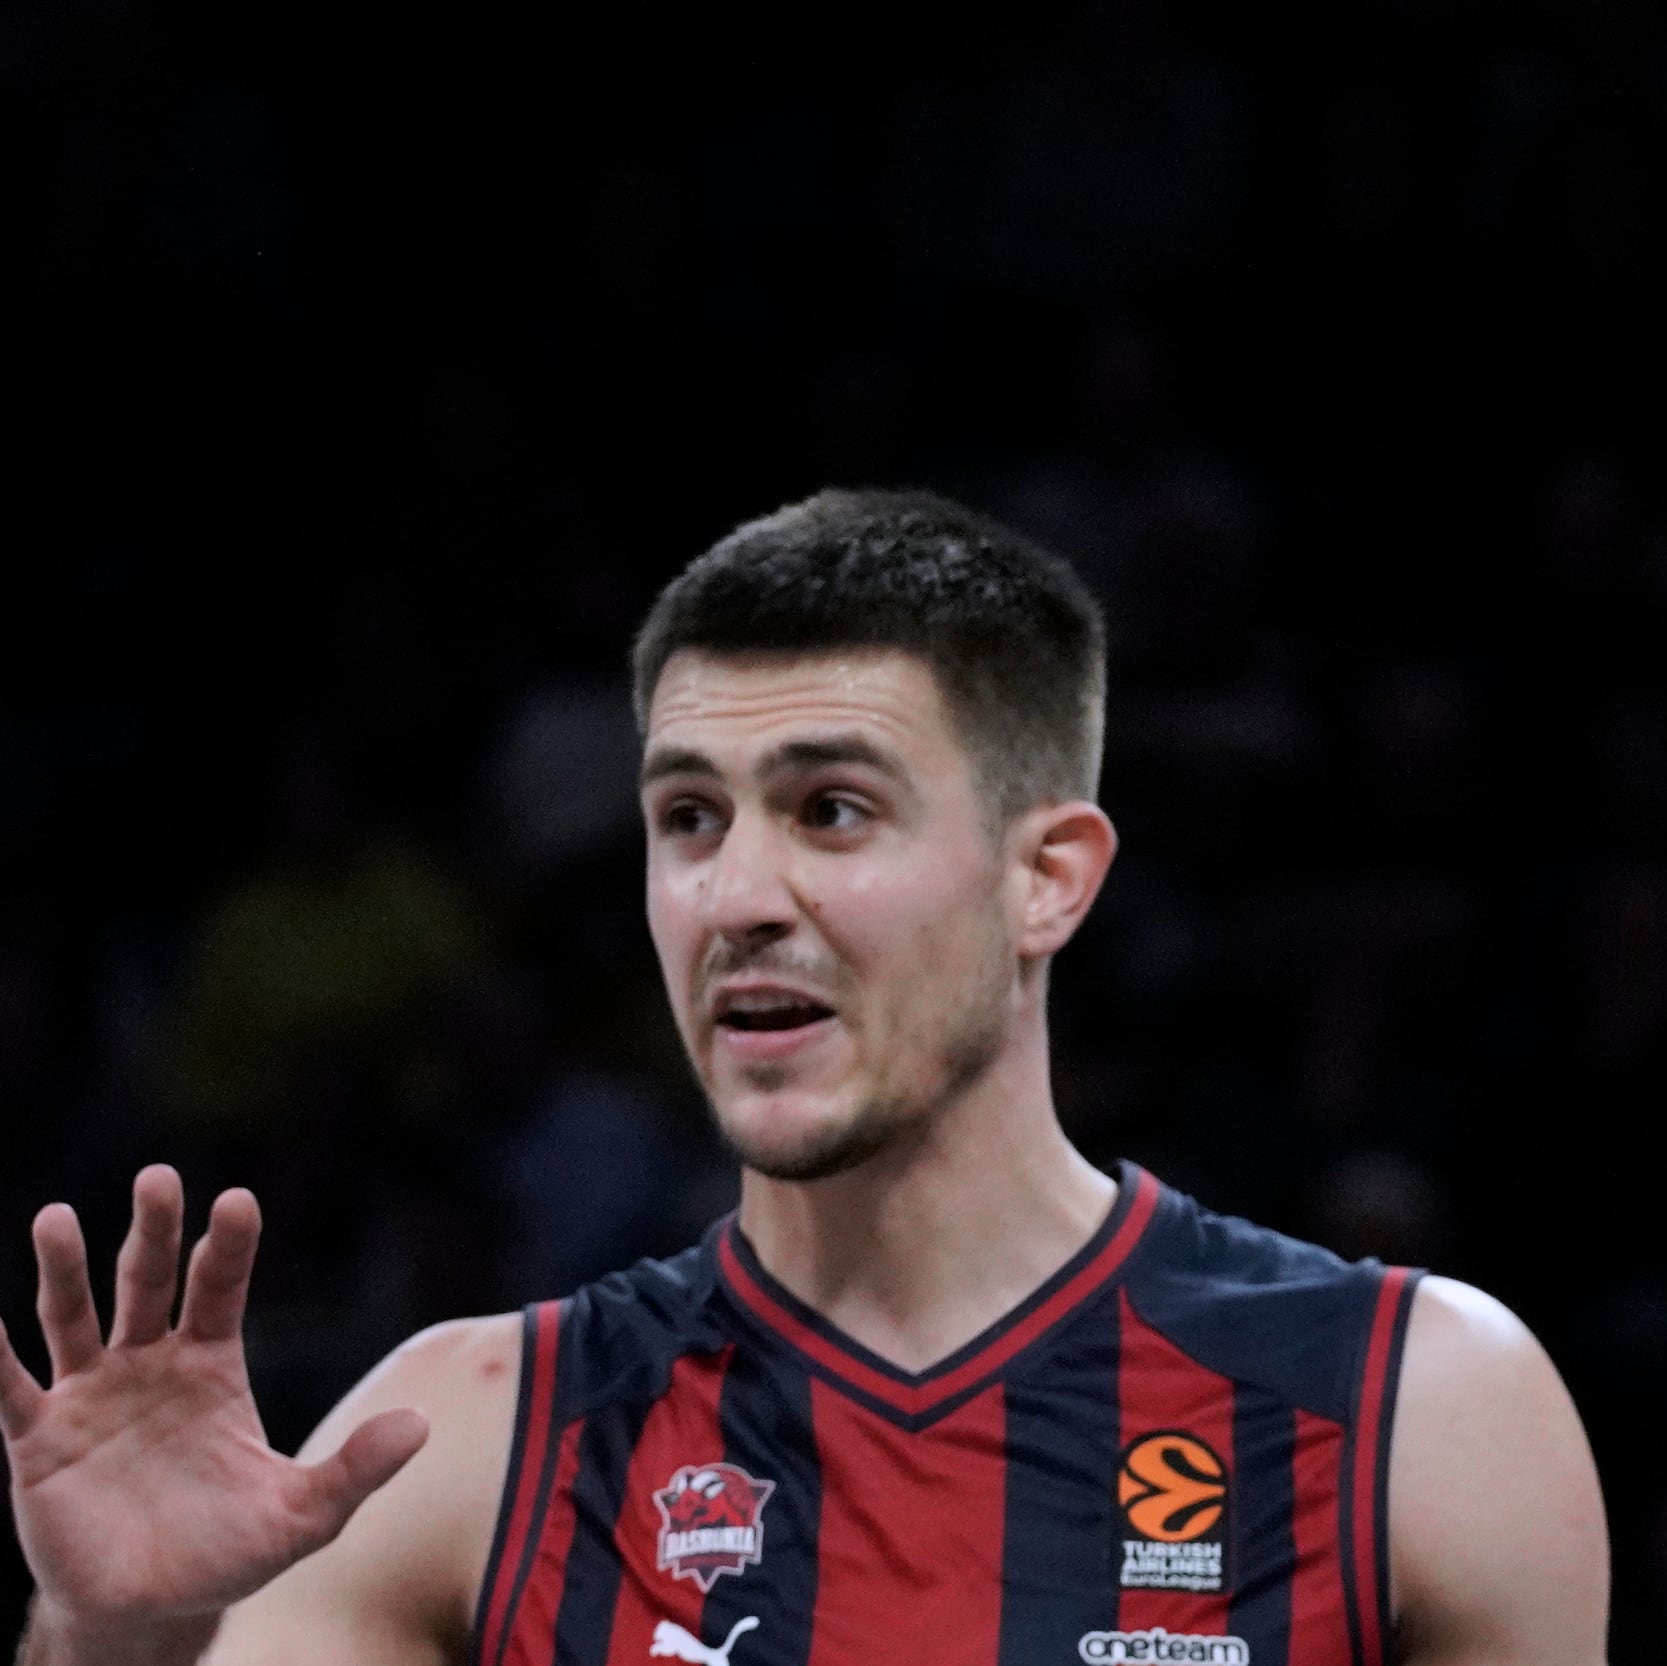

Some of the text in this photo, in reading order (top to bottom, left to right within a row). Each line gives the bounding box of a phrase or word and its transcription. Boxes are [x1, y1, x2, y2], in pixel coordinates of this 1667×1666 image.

[1121, 1540, 1223, 1558] TURKISH
[1121, 1556, 1223, 1576] AIRLINES
[1085, 1633, 1243, 1663] oneteam
